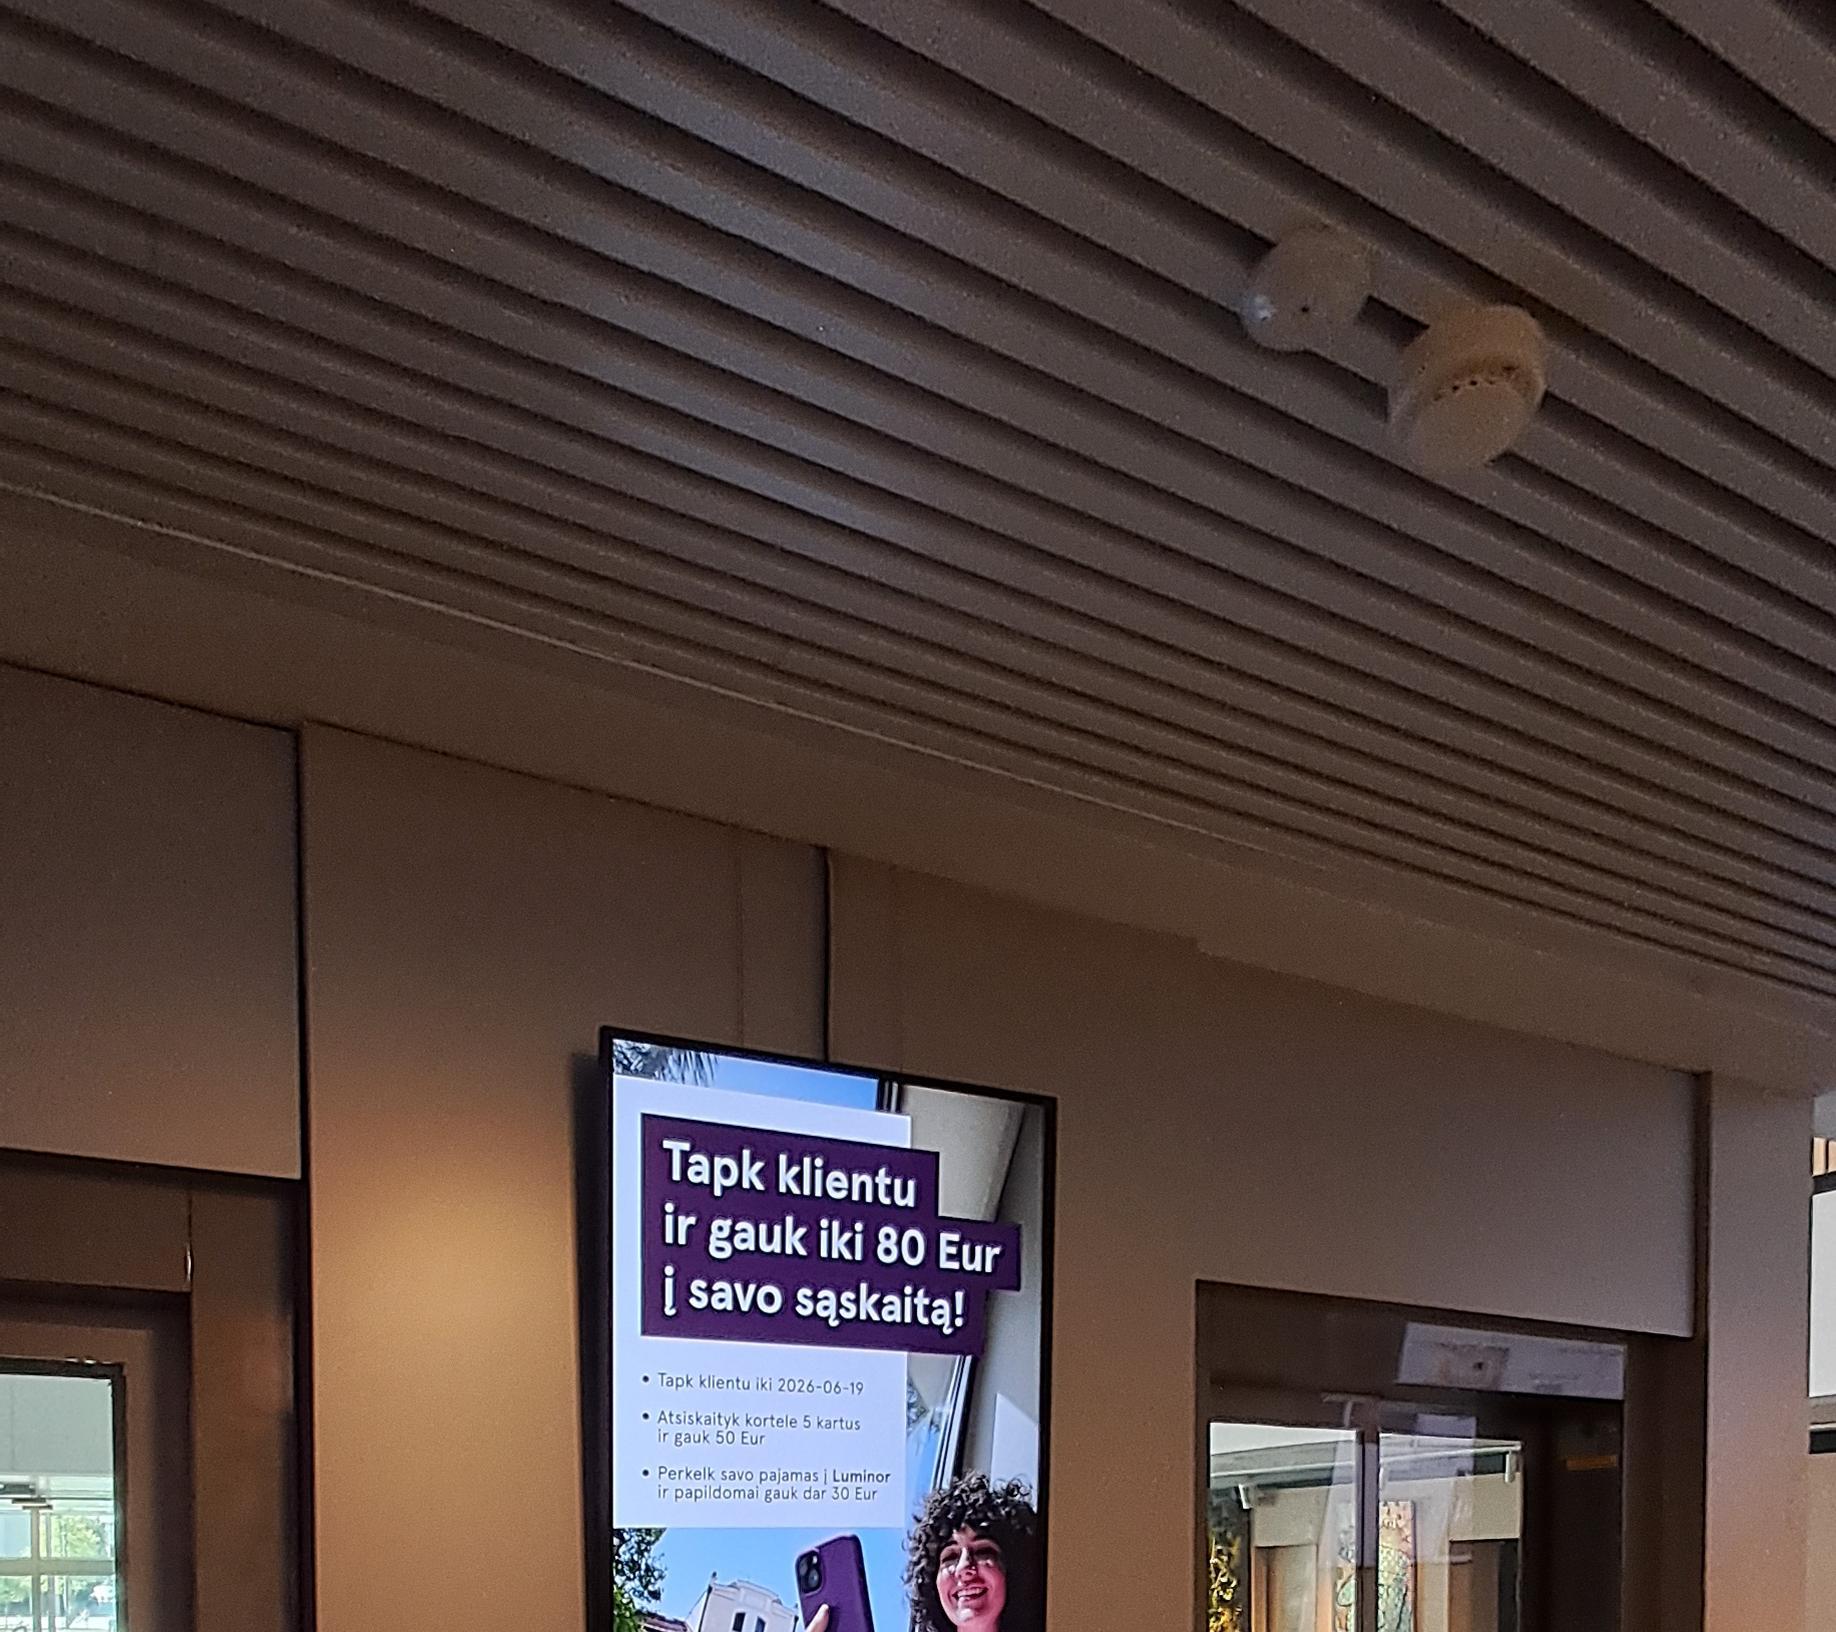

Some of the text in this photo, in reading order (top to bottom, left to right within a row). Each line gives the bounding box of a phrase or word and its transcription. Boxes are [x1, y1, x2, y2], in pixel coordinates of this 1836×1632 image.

[662, 1139, 916, 1207] Tapk klientu
[664, 1204, 1002, 1273] ir gauk iki 80 Eur
[663, 1266, 965, 1335] į savo sąskaitą!
[658, 1372, 864, 1396] Tapk klientu iki 2026-06-19
[657, 1410, 861, 1431] Atsiskaityk kortele 5 kartus
[658, 1429, 766, 1448] ir gauk 50 Eur
[658, 1466, 716, 1482] Perkelk
[720, 1470, 754, 1482] savo
[759, 1469, 819, 1485] pajamas
[833, 1468, 892, 1484] Luminor
[658, 1485, 878, 1503] ir papildomai gauk dar 30 Eur
